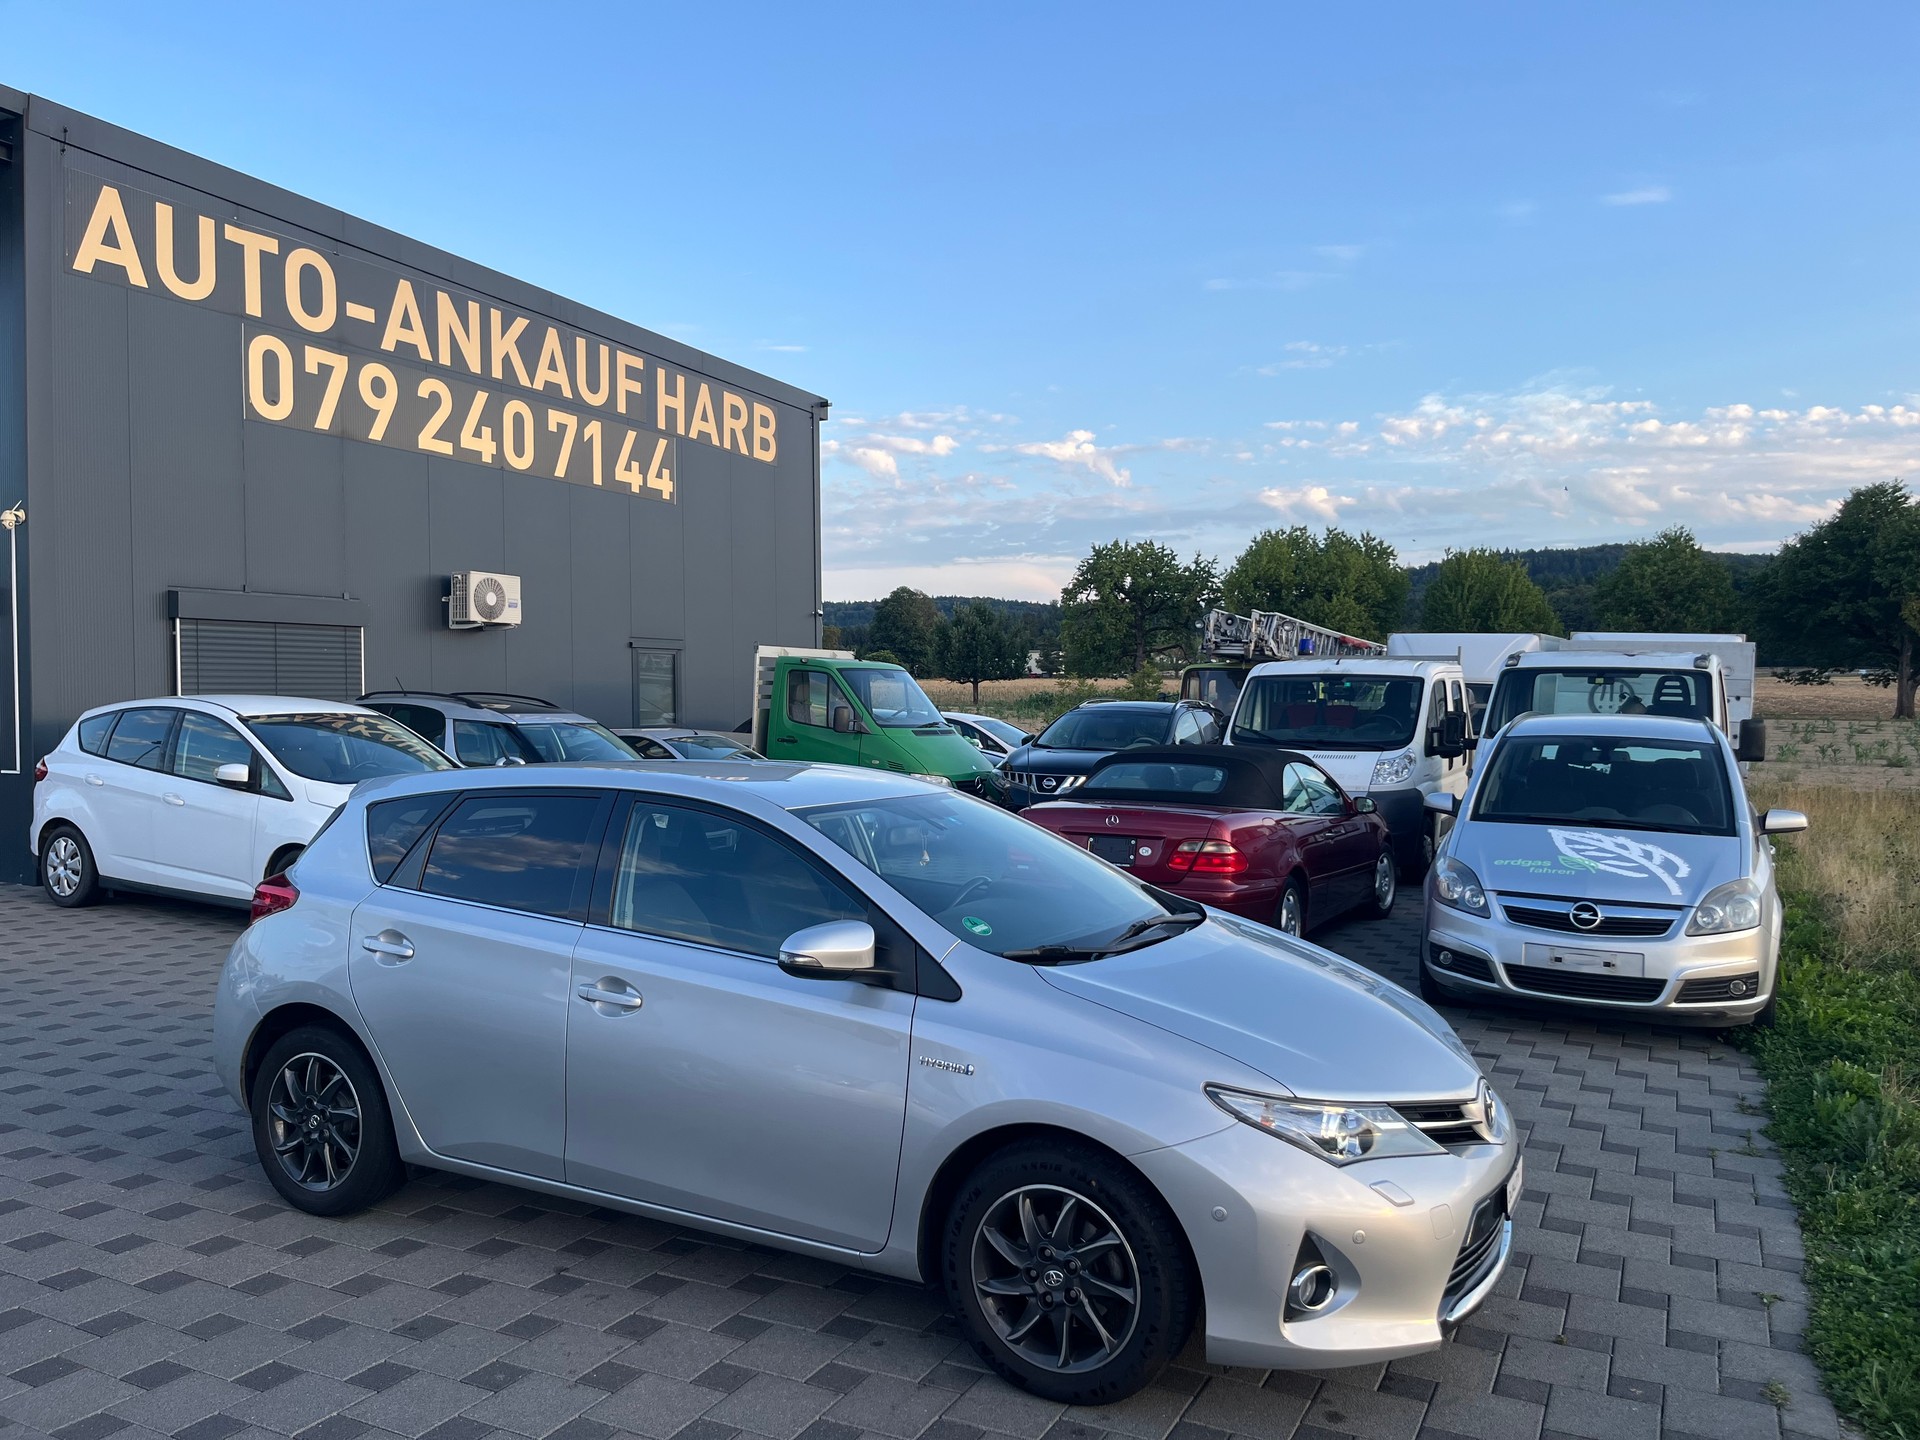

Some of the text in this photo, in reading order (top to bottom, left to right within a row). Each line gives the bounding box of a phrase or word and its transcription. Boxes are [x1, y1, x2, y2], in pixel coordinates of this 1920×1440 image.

[72, 185, 777, 463] AUTO-ANKAUF HARB
[248, 334, 399, 442] 079
[417, 377, 535, 471] 240
[1494, 859, 1552, 867] erdgas
[1529, 867, 1576, 875] fahren
[919, 1055, 966, 1075] HYBRID
